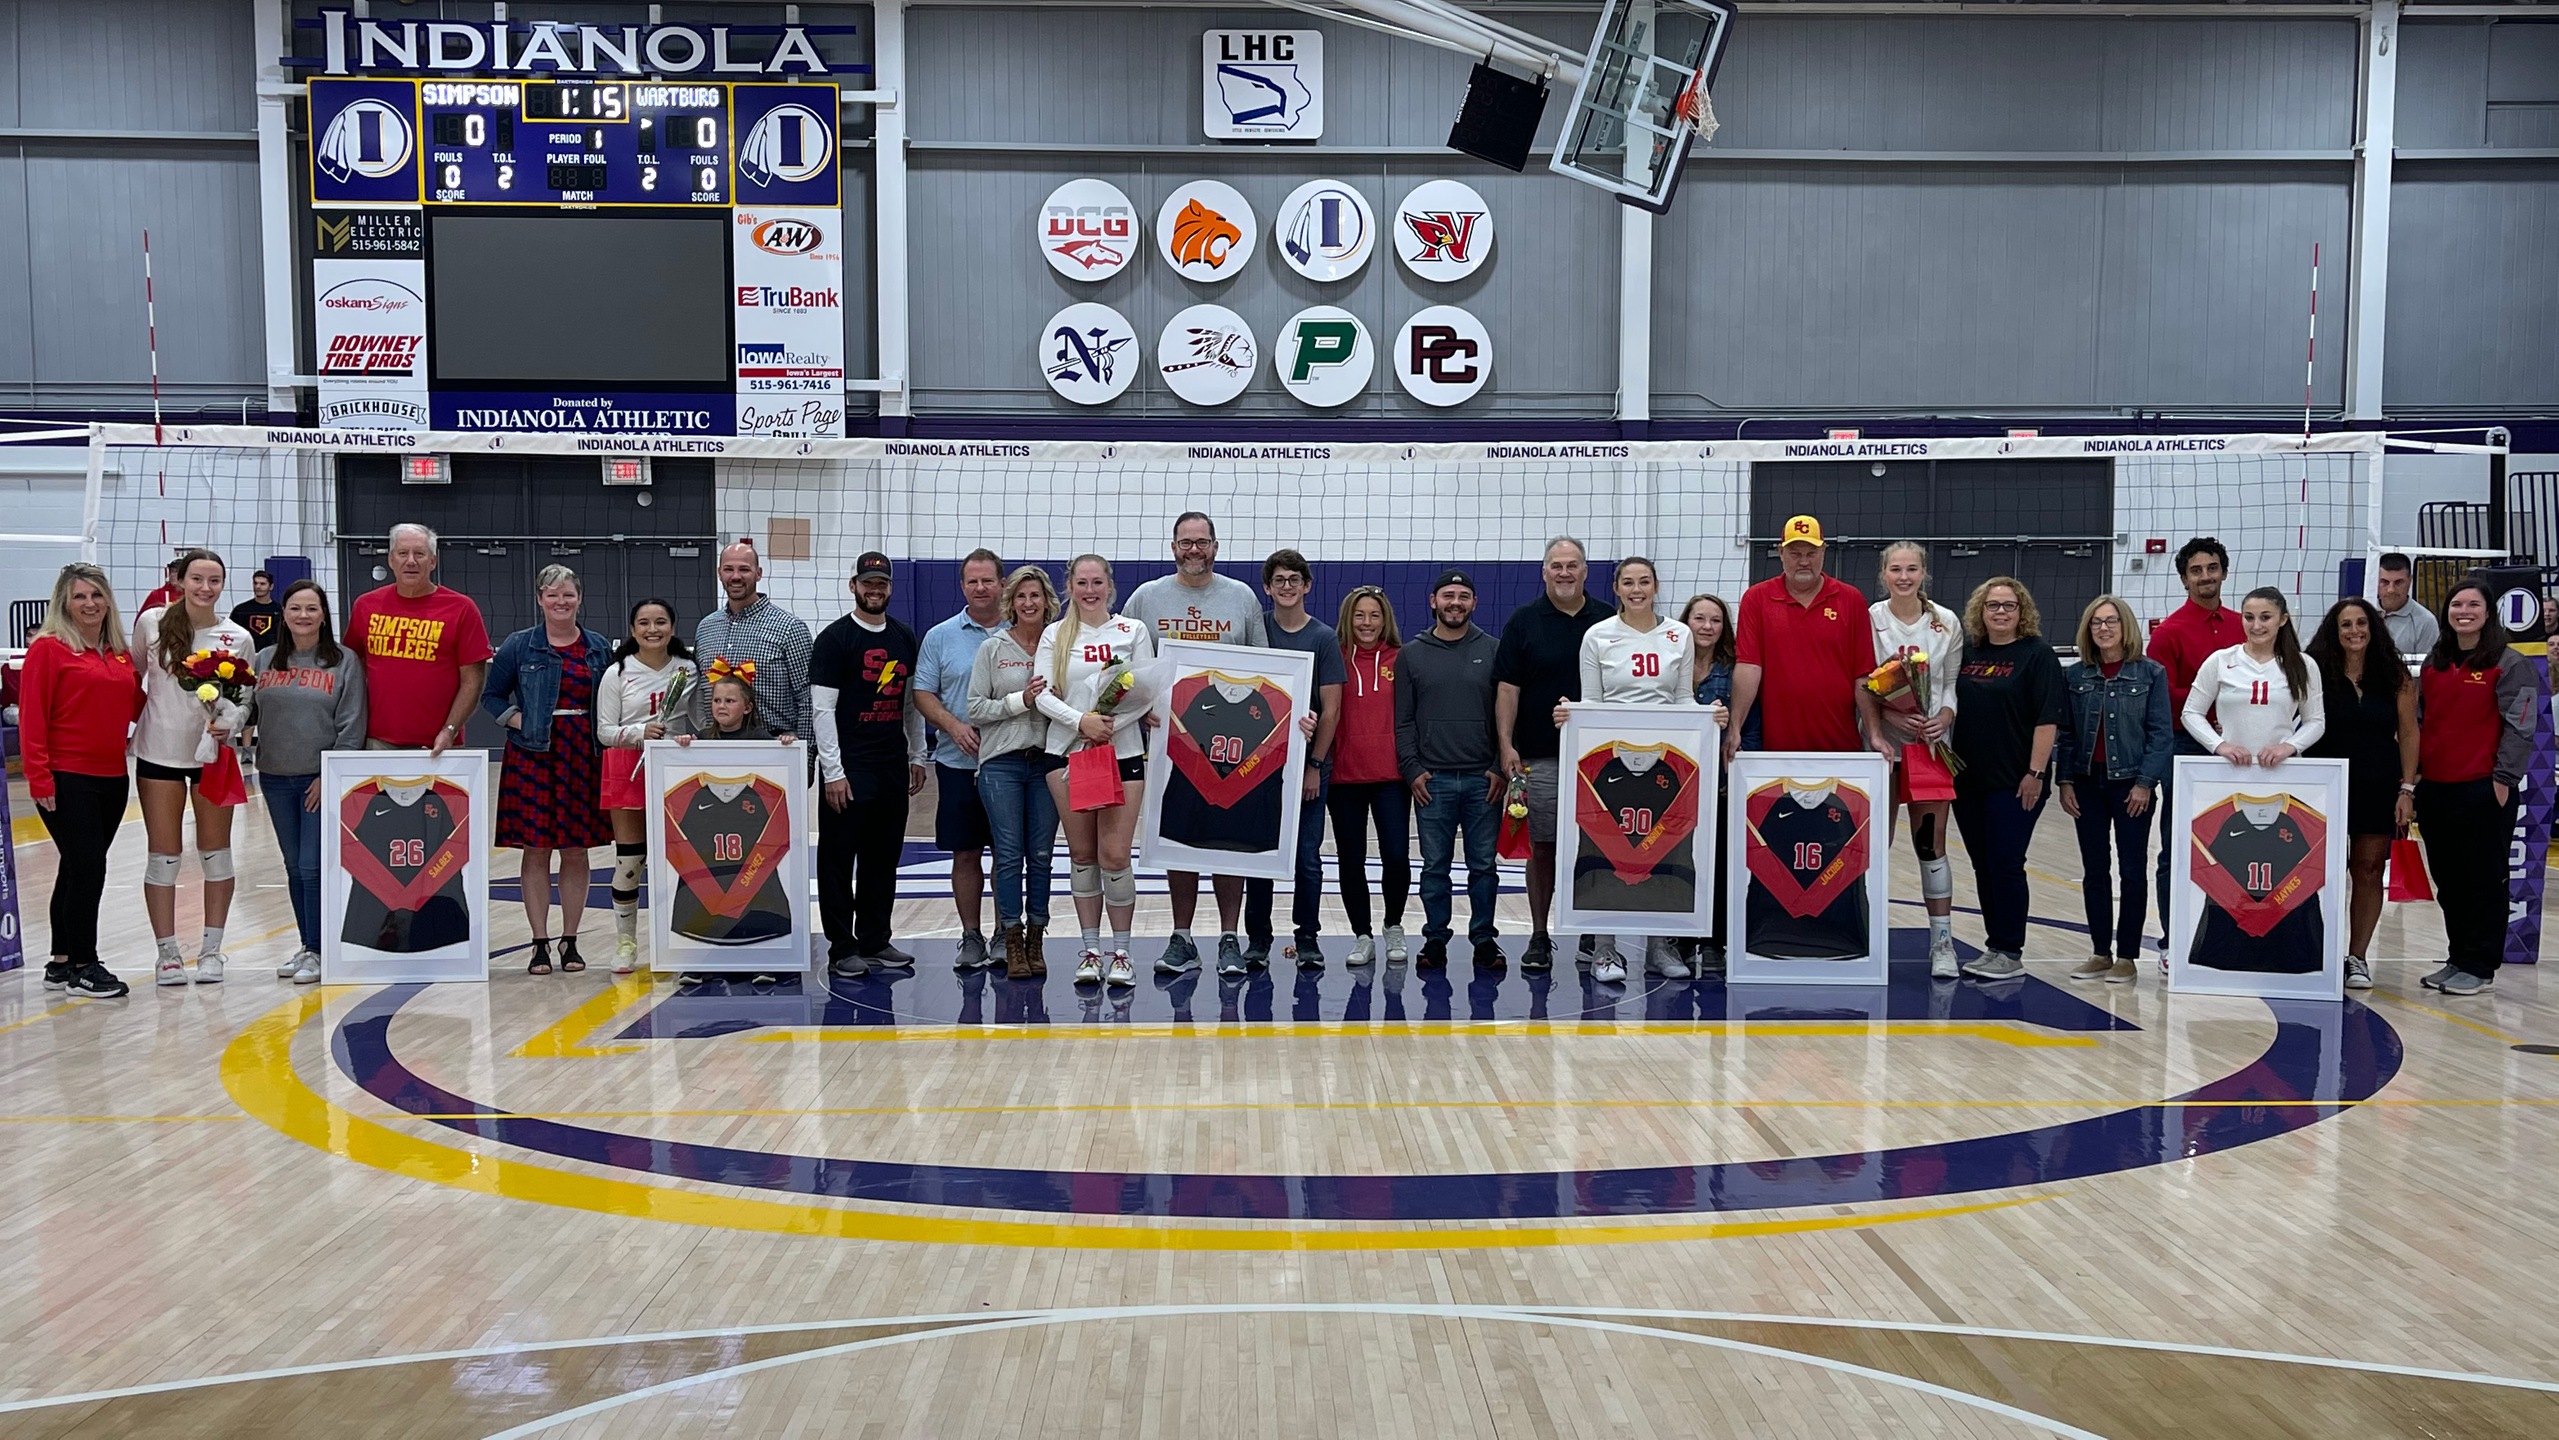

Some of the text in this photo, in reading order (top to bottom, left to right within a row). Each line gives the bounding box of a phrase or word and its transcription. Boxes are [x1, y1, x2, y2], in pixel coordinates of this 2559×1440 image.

[322, 10, 828, 75] INDIANOLA
[1218, 35, 1294, 60] LHC
[422, 84, 520, 105] SIMPSON
[562, 87, 621, 118] 1:15
[636, 87, 719, 107] WARTBURG
[465, 114, 485, 146] 0
[549, 134, 582, 143] PERIOD
[594, 129, 603, 149] 1
[697, 117, 716, 148] 0
[434, 152, 463, 162] FOULS
[492, 153, 516, 163] T.O.L.
[546, 154, 607, 164] PLAYER FOUL
[637, 155, 660, 164] T.O.L.
[690, 155, 719, 165] FOULS
[445, 165, 461, 189] 0
[497, 165, 513, 189] 2
[641, 167, 657, 191] 2
[701, 167, 717, 191] 0
[436, 190, 465, 200] SCORE
[562, 191, 593, 200] MATCH
[691, 192, 720, 201] SCORE
[358, 215, 411, 226] MILLER
[737, 213, 758, 225] Gib's
[1047, 206, 1128, 236] DCG
[350, 227, 421, 237] ELECTRIC
[764, 227, 811, 247] A&W
[352, 240, 420, 251] 515-961-5842
[760, 287, 839, 307] TruBank
[329, 335, 423, 352] DOWNEY
[1287, 318, 1361, 385] P
[321, 353, 416, 375] TIRE PROS
[786, 352, 828, 367] Realty
[1411, 325, 1478, 383] PC
[750, 380, 831, 390] 515-961-7416
[330, 401, 417, 417] BRICKHOUSE
[553, 398, 613, 409] Donated by
[457, 410, 710, 428] INDIANOLA ATHLETIC
[739, 401, 842, 437] Sports Page
[267, 431, 416, 447] INDIANOLA ATHLETICS
[577, 439, 725, 452] INDIANOLA ATHLETICS
[2084, 438, 2225, 452] INDIANOLA ATHLETICS
[885, 444, 1030, 457] INDIANOLA ATHLETICS
[1188, 447, 1331, 459] INDIANOLA ATHLETICS
[1487, 446, 1629, 458] INDIANOLA ATHLETICS
[1785, 444, 1928, 457] INDIANOLA ATHLETICS
[1187, 606, 1202, 619] SC
[1824, 607, 1837, 621] SC
[367, 613, 445, 642] SIMPSON
[1117, 623, 1131, 634] SC
[1158, 619, 1231, 632] STORM
[1666, 630, 1679, 643] SC
[367, 635, 439, 662] COLLEGE
[1084, 643, 1112, 663] 20
[997, 659, 1035, 670] Simp
[1631, 653, 1660, 677] 30
[257, 667, 335, 696] SIMPSON
[2250, 680, 2269, 705] 11
[1210, 735, 1243, 764] 20
[1238, 755, 1260, 778] PARKS
[1619, 807, 1652, 835] 30
[390, 839, 424, 866] 26
[714, 833, 742, 861] 18
[1794, 842, 1822, 870] 16
[740, 853, 765, 887] SANCHEZ
[1821, 858, 1844, 885] JACOBS
[2247, 862, 2272, 890] 11
[2274, 876, 2301, 904] HAYNES
